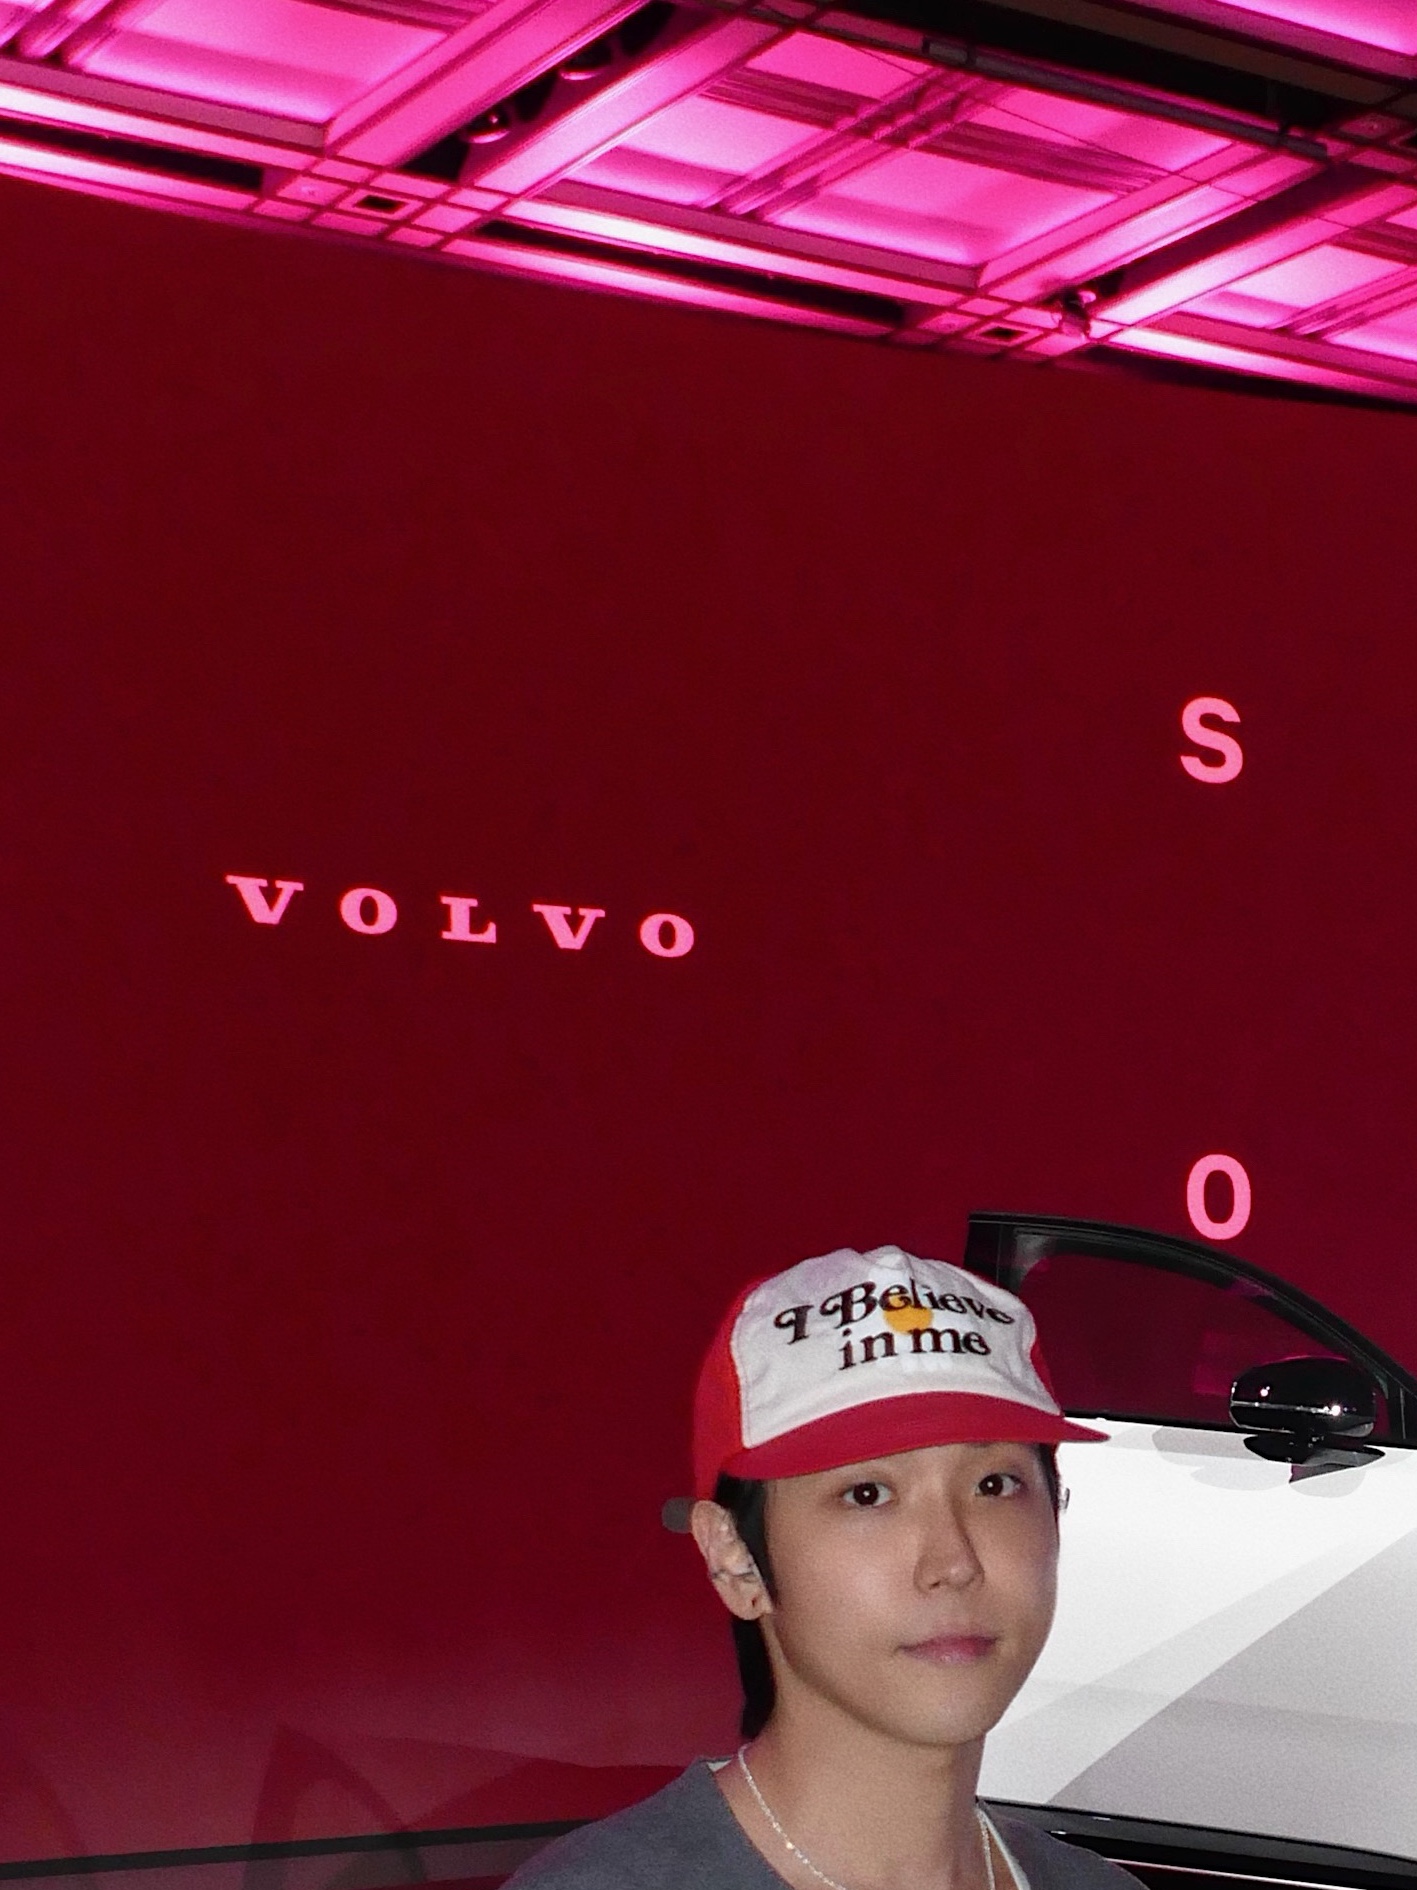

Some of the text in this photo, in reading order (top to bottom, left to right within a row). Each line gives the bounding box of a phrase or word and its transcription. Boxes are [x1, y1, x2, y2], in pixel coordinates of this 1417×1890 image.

[1180, 696, 1244, 784] S
[225, 874, 696, 958] VOLVO
[774, 1278, 1015, 1345] I Believe
[838, 1326, 992, 1371] in me
